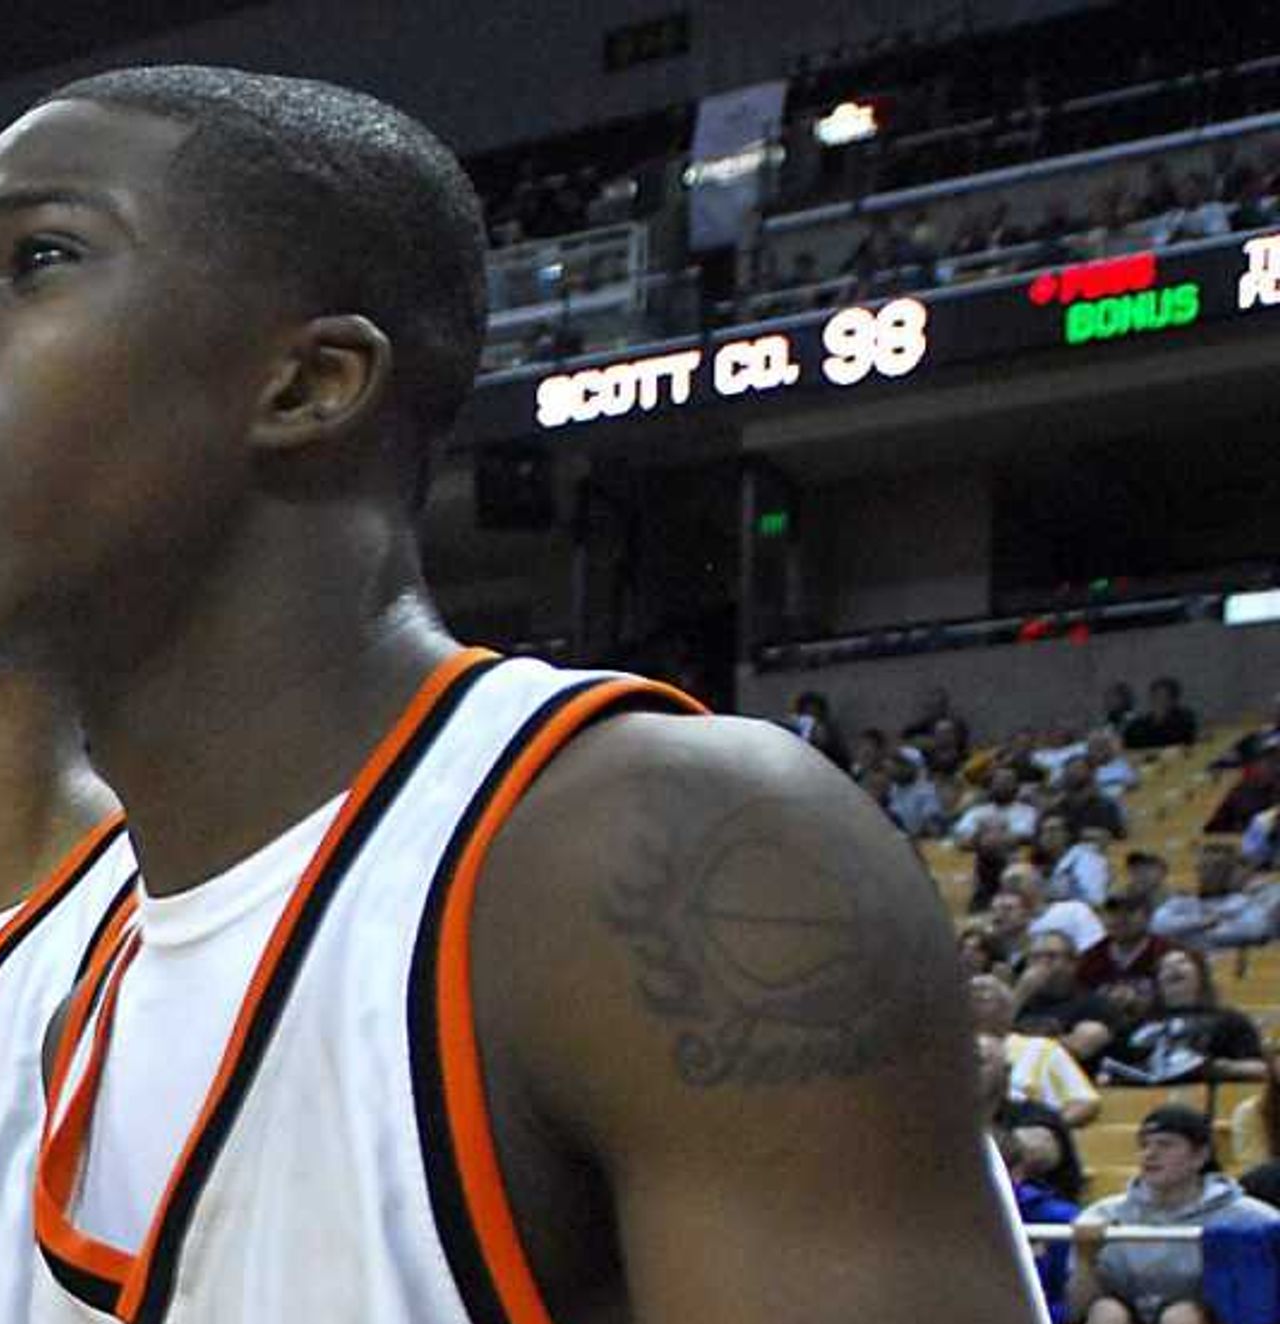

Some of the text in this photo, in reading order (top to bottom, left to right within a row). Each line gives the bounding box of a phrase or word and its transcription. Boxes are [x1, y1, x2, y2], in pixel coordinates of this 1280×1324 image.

[1066, 283, 1199, 345] BONUS
[537, 298, 927, 428] SCOTT CO. 98
